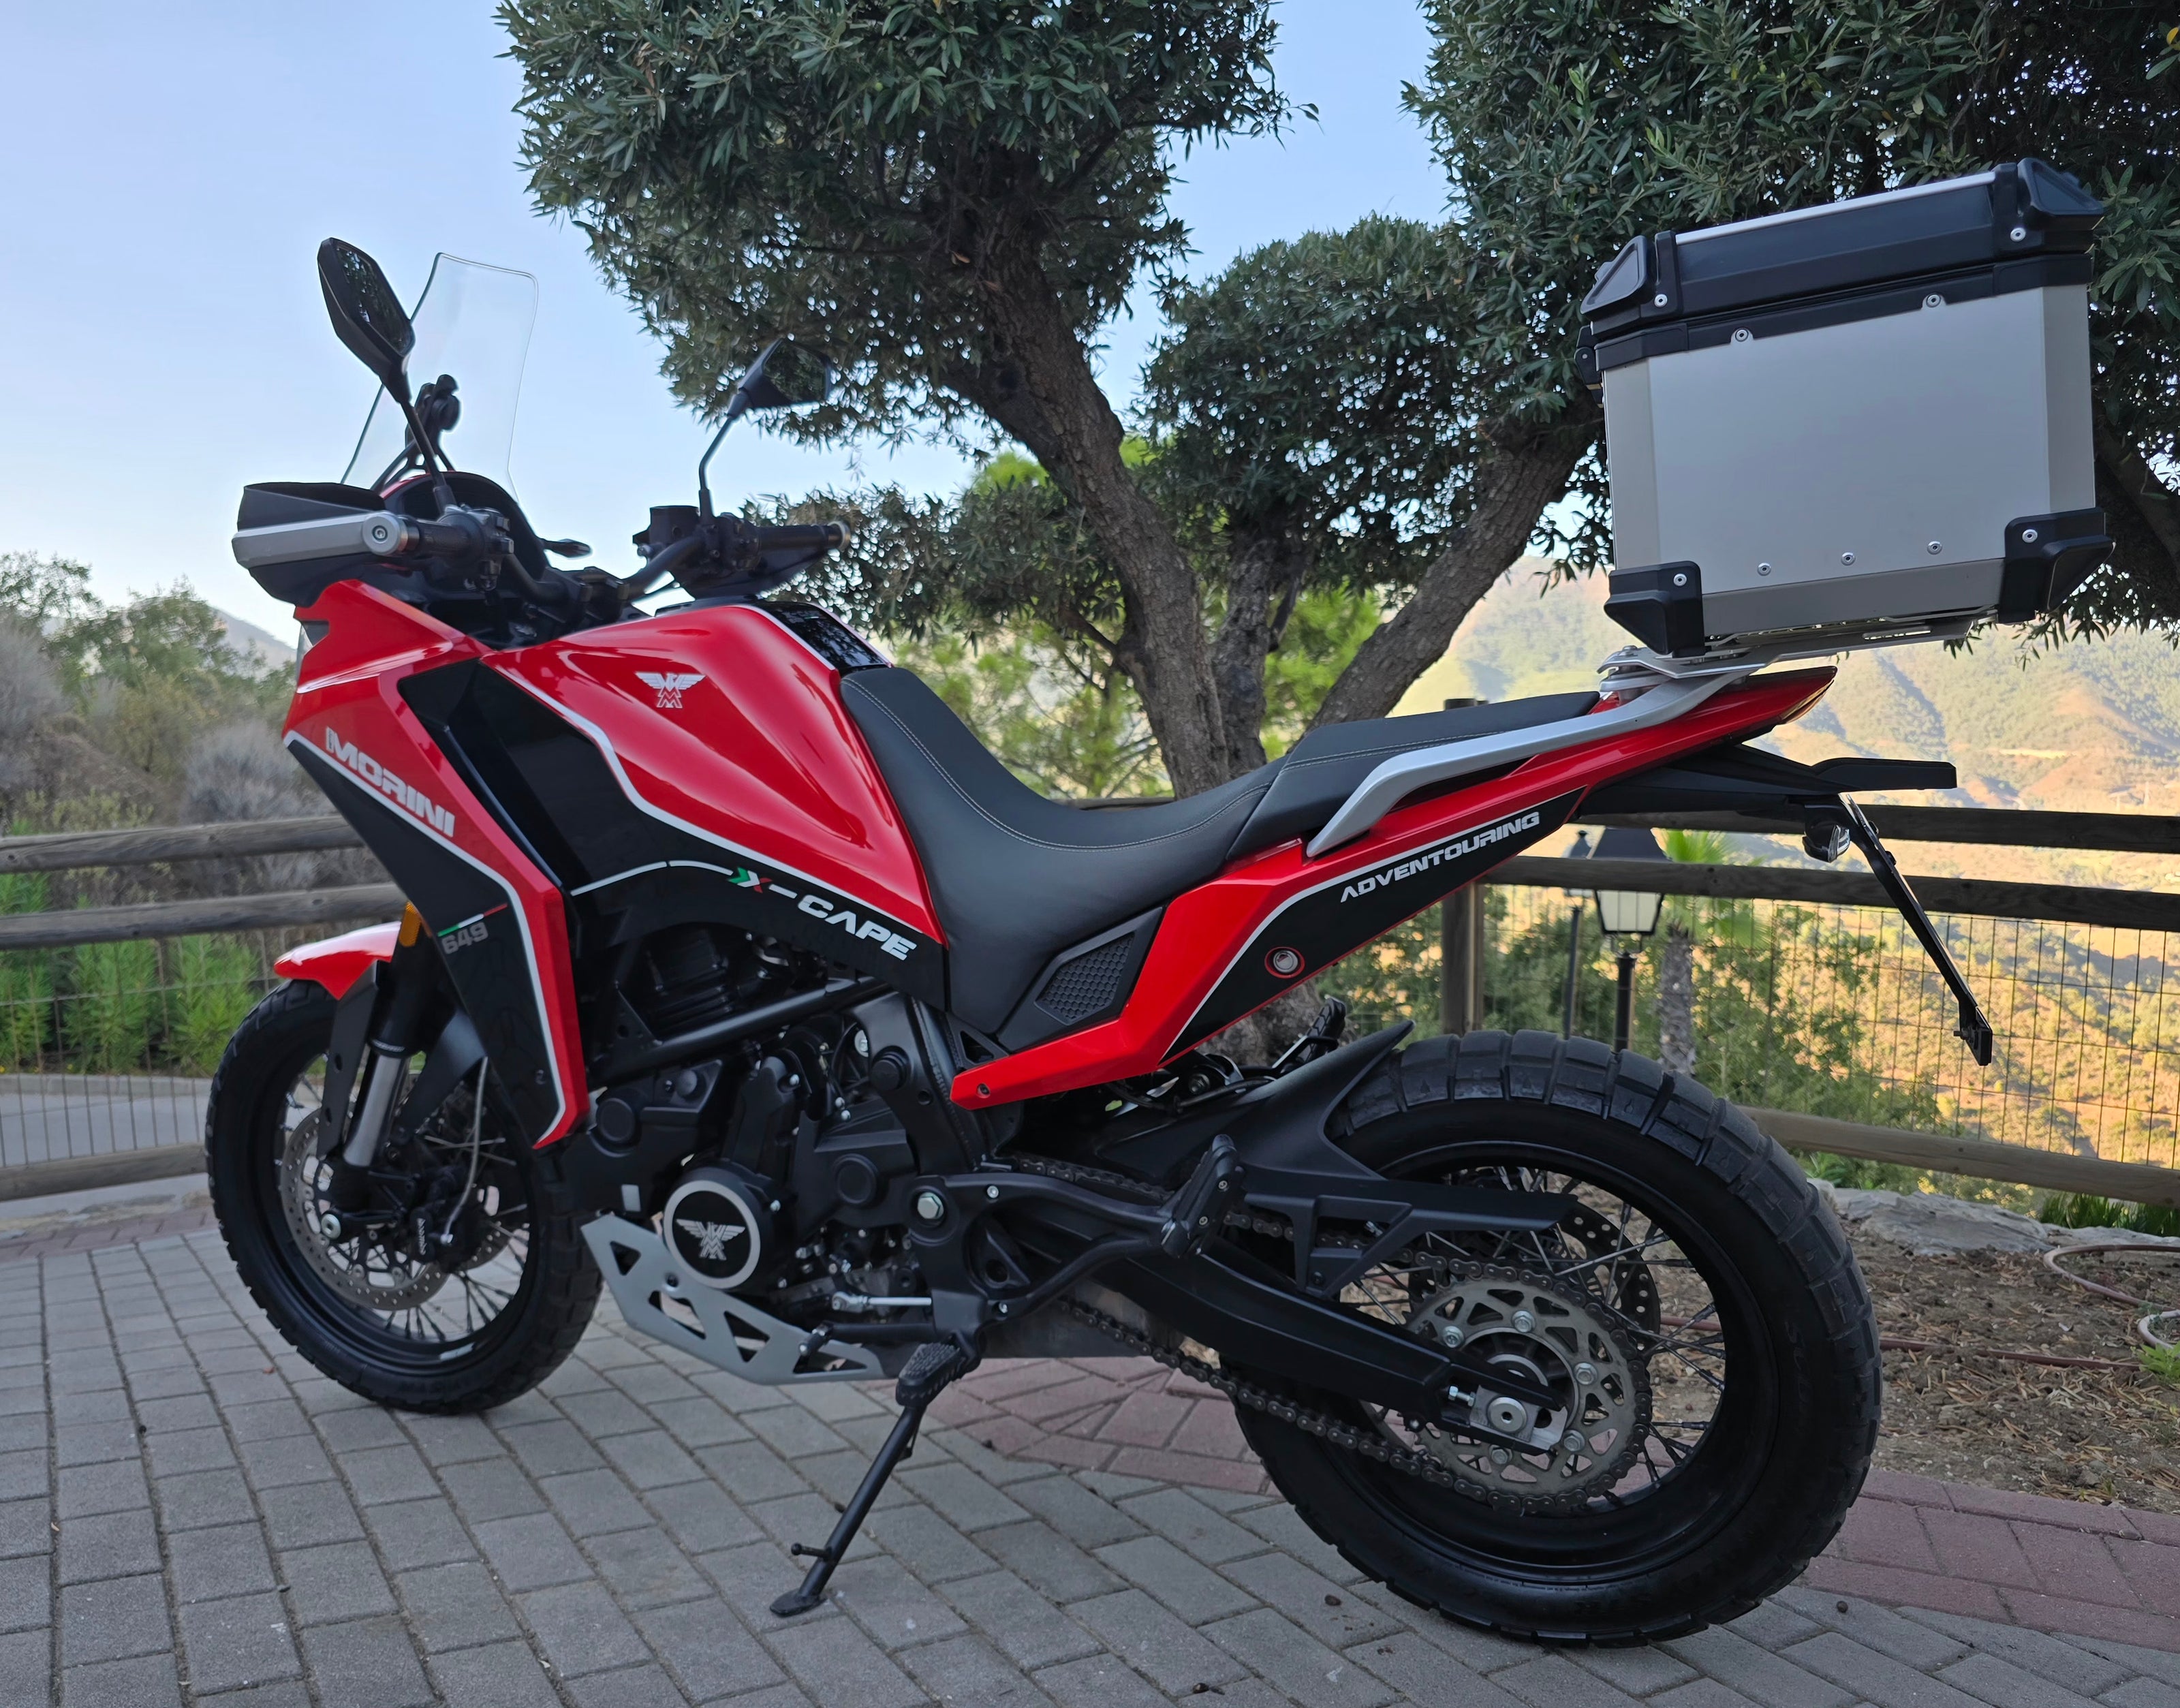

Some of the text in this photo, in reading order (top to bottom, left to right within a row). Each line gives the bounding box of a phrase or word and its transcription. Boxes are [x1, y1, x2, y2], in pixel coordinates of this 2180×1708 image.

[326, 727, 455, 837] MORINI
[1341, 811, 1540, 903] ADVENTOURING
[441, 922, 488, 954] 649
[729, 867, 917, 961] X-CAPE
